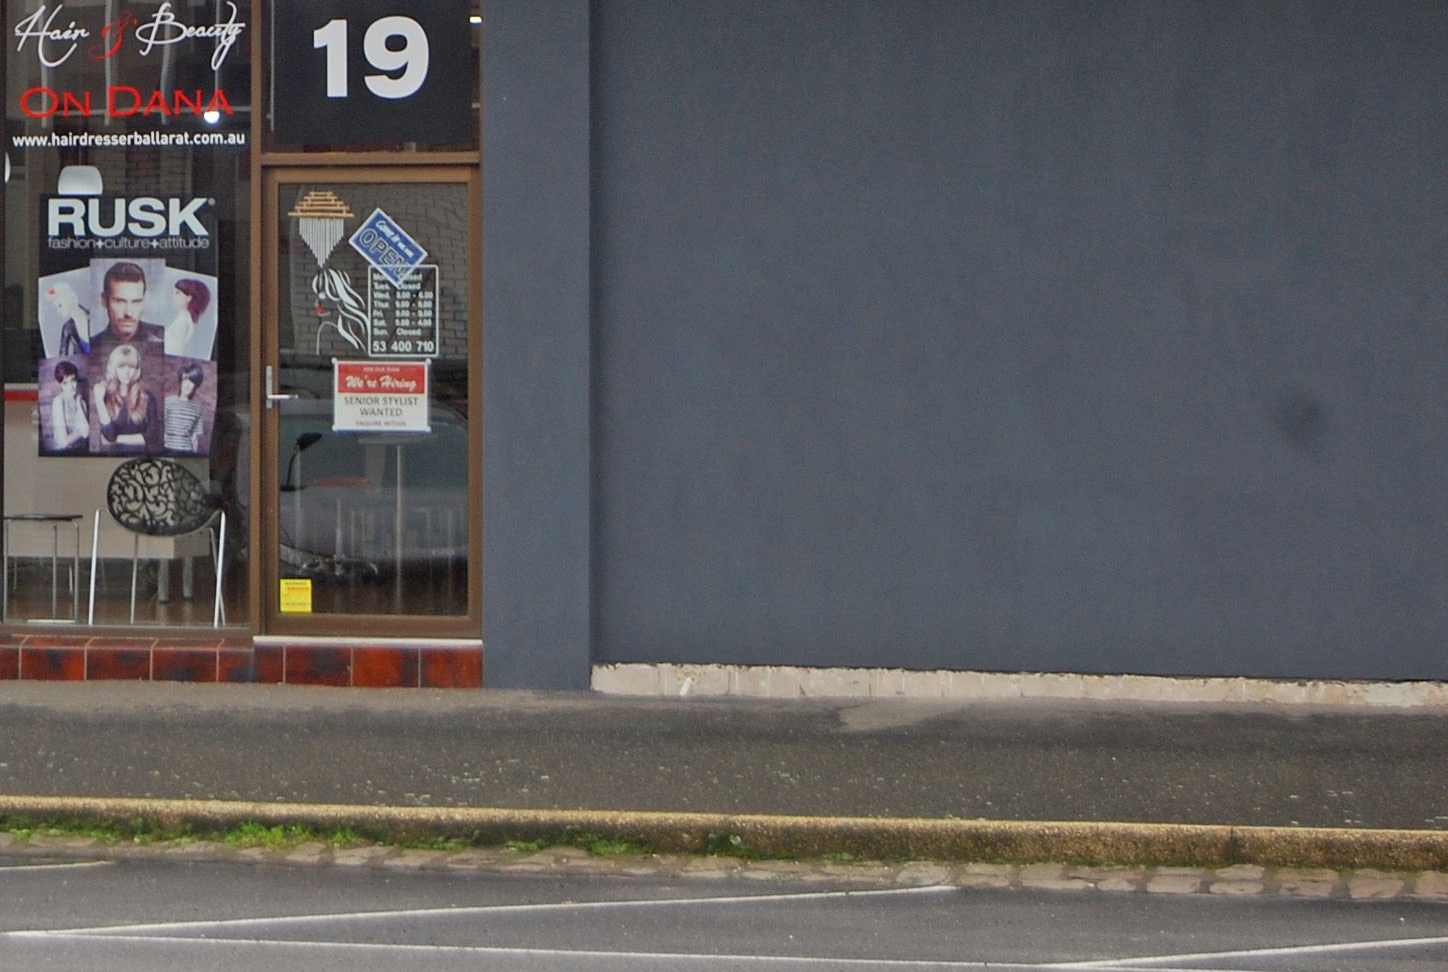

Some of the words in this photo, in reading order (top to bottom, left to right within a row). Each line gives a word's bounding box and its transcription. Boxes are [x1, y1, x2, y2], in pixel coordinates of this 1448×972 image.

[14, 4, 90, 67] Hair
[135, 1, 246, 70] Beauty
[313, 15, 429, 99] 19
[20, 85, 92, 118] ON
[108, 85, 234, 117] DANA
[12, 131, 246, 147] www.hairdresserballarat.com.au
[48, 198, 209, 236] RUSK
[359, 228, 410, 278] OPEN
[373, 340, 387, 352] 53
[391, 340, 412, 352] 400
[416, 340, 434, 352] 710
[345, 375, 378, 388] We're
[379, 375, 416, 392] Hiring
[344, 396, 380, 405] SENIOR
[382, 396, 418, 405] STYLIST
[360, 407, 403, 416] WANTED
